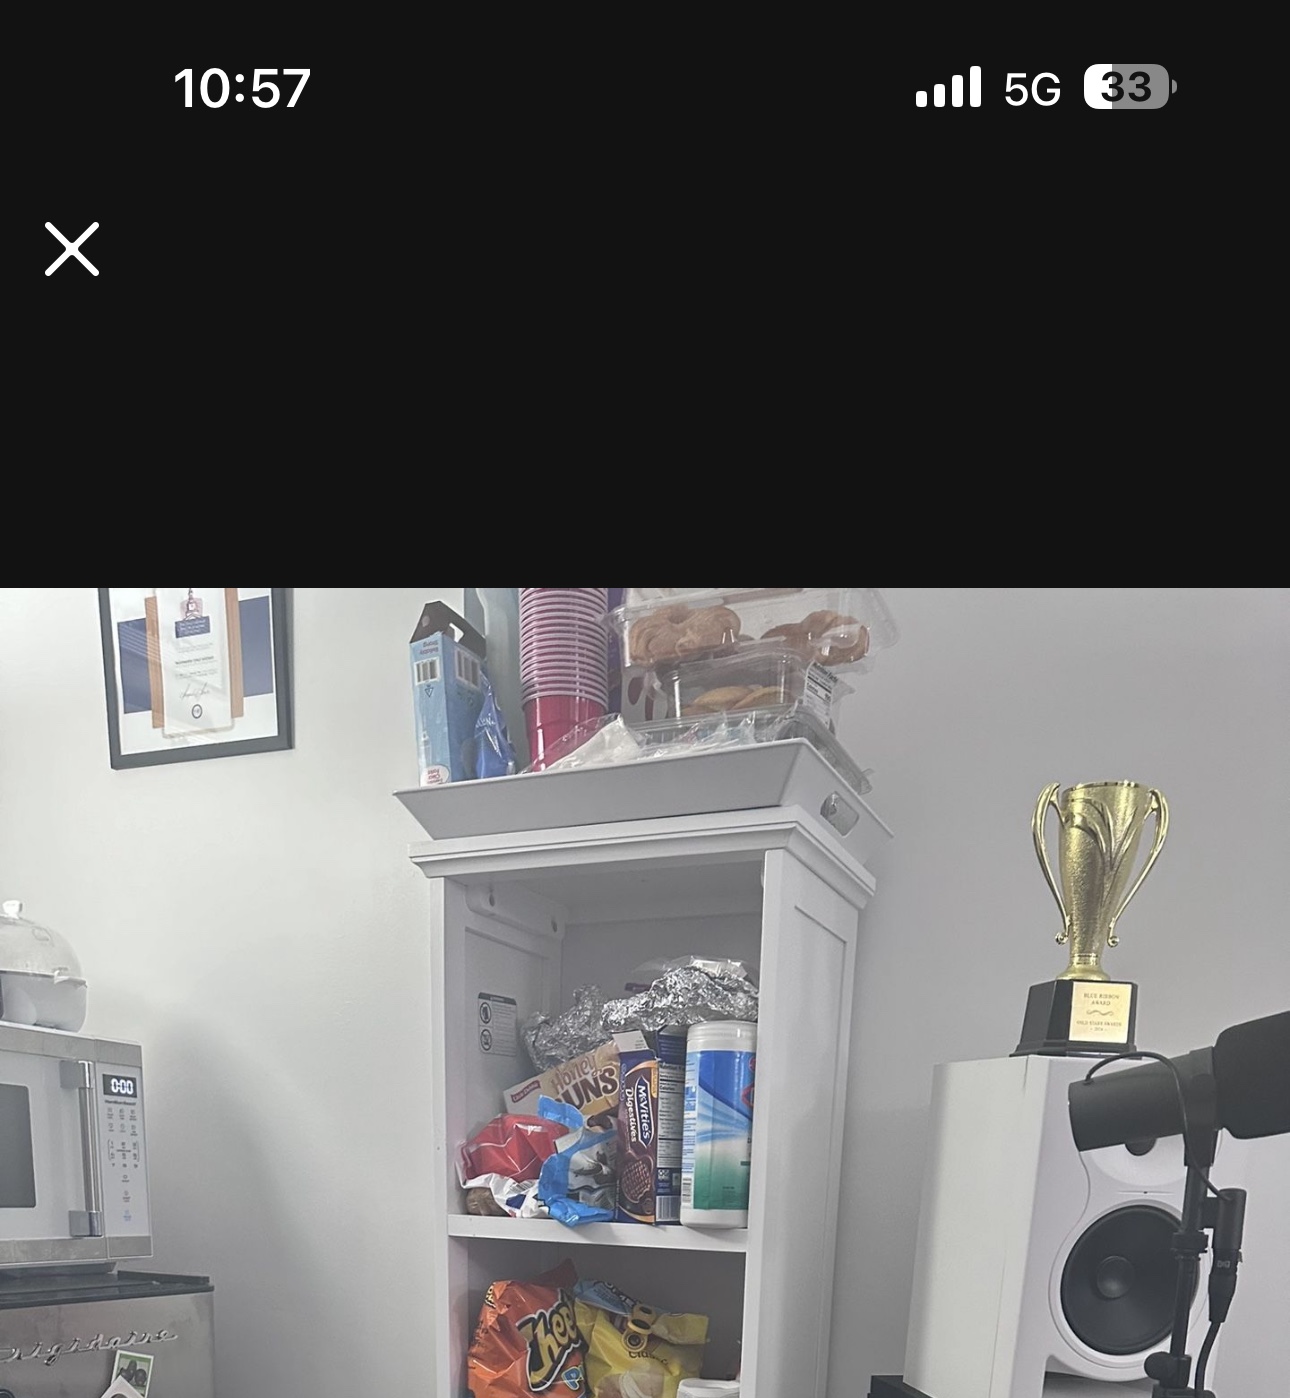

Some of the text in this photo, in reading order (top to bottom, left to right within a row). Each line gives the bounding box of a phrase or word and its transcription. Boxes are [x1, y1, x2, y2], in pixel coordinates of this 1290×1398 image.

[110, 1078, 134, 1095] 0:00
[551, 1054, 603, 1095] Honey
[554, 1066, 620, 1111] UNS
[625, 1086, 637, 1143] Digestives
[637, 1084, 651, 1140] McVitie's
[0, 1329, 179, 1367] rigidaire
